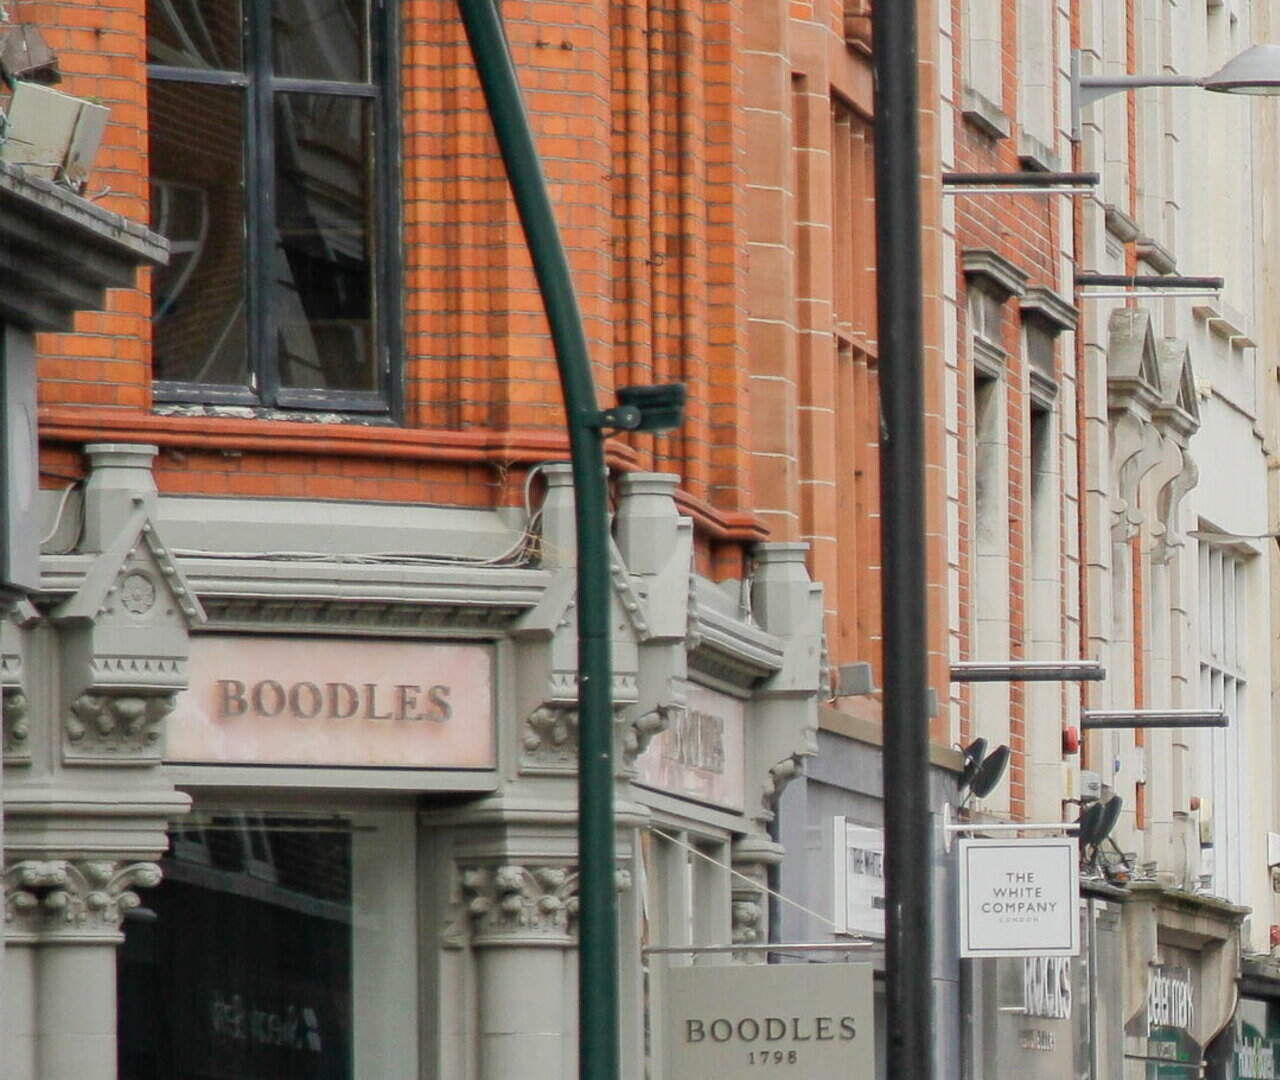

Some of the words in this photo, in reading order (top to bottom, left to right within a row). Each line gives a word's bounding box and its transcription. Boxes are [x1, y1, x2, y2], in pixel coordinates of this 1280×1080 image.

[216, 680, 452, 722] BOODLES
[1006, 873, 1034, 883] THE
[993, 887, 1042, 898] WHITE
[981, 902, 1057, 913] COMPANY
[686, 1016, 856, 1043] BOODLES
[749, 1051, 797, 1065] 1798
